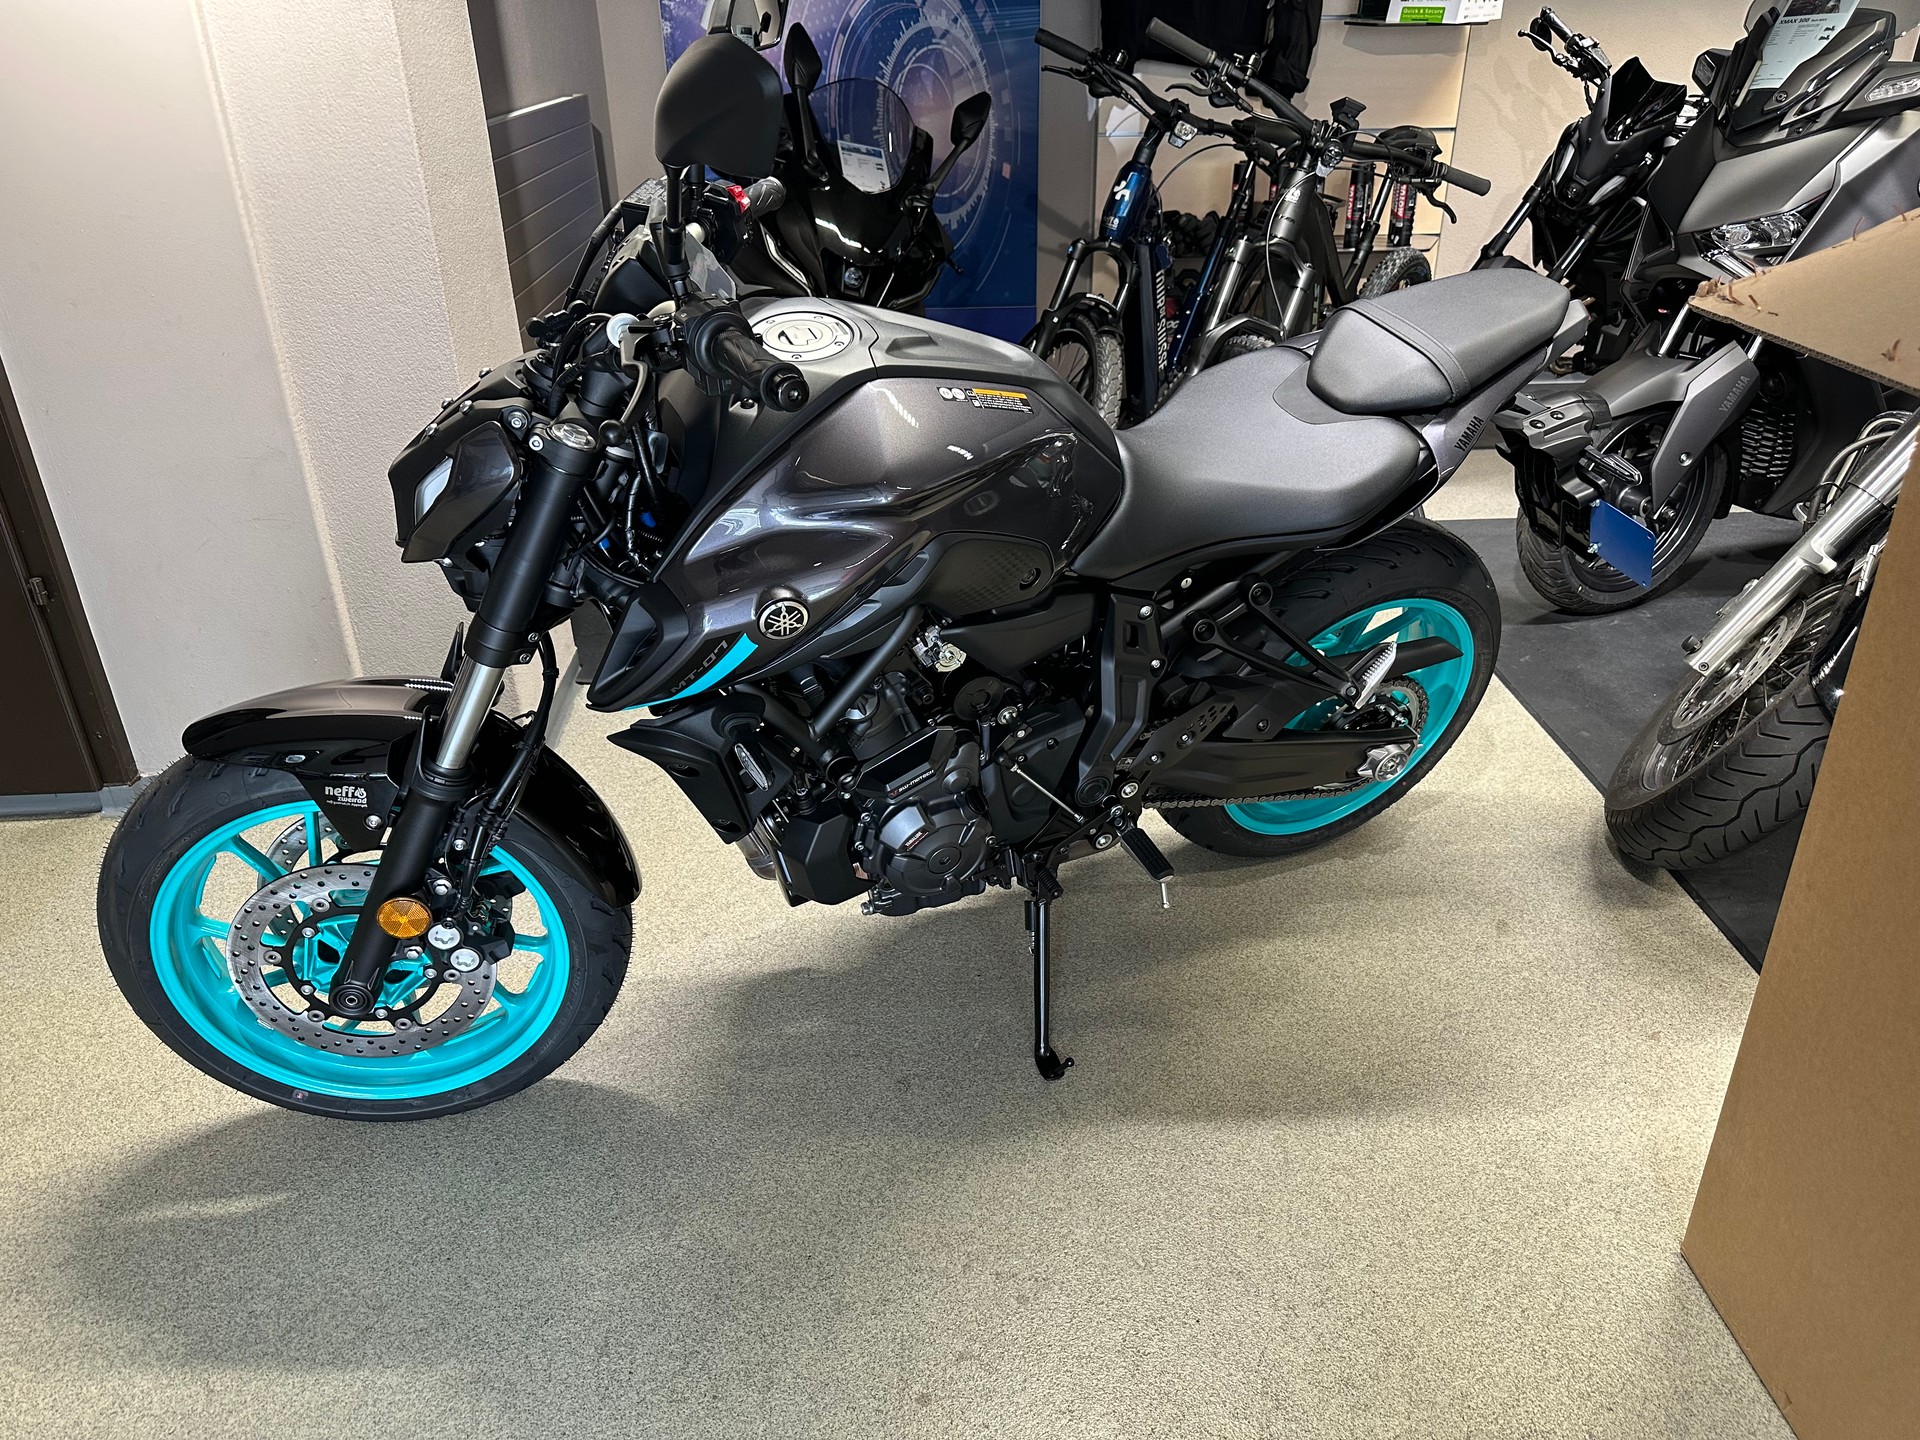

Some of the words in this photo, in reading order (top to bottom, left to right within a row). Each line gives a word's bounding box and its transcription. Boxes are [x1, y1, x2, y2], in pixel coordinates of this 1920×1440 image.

[1397, 184, 1408, 217] MOTUL
[1719, 375, 1750, 412] YAMAHA
[1454, 415, 1485, 452] YAMAHA
[670, 640, 728, 694] MT-07
[325, 785, 356, 798] neff
[337, 796, 368, 804] zweirad
